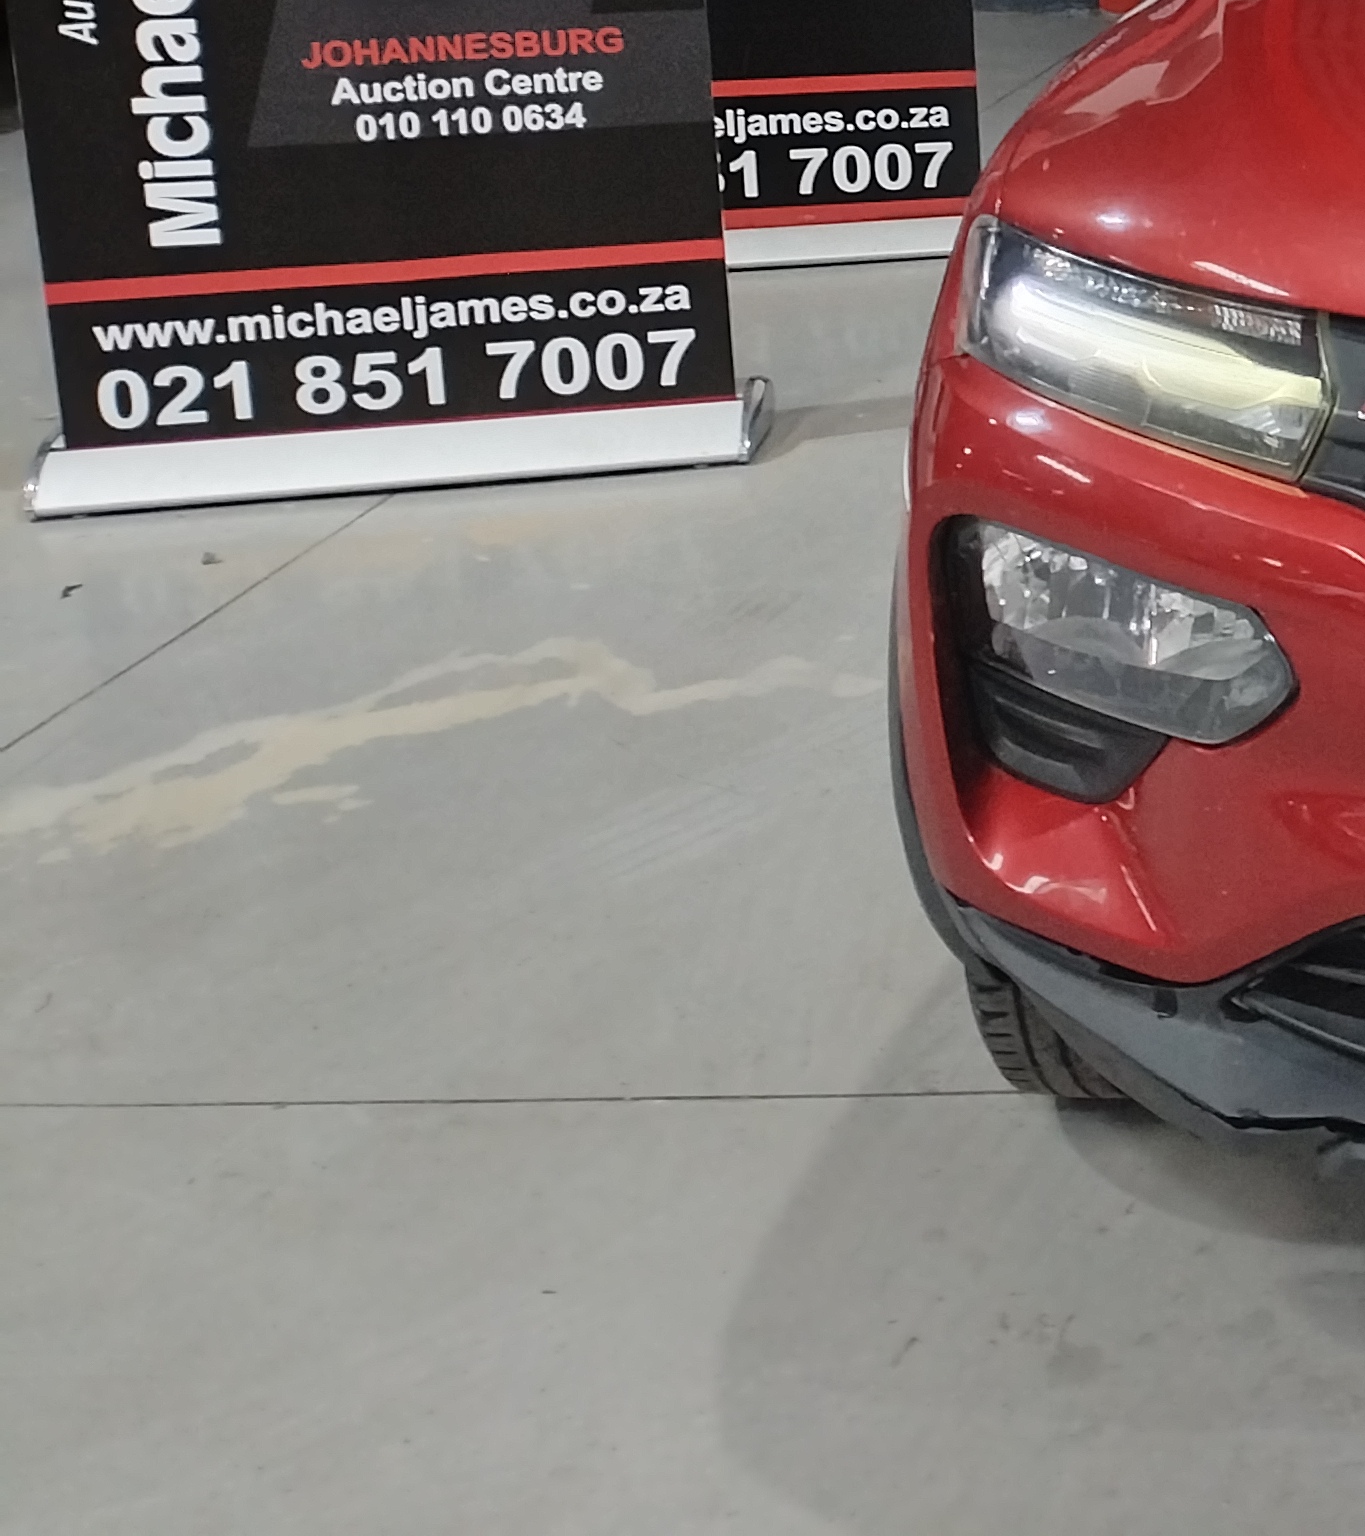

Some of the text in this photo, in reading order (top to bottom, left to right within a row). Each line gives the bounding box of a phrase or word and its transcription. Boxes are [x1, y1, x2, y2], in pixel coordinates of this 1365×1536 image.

[301, 26, 625, 70] JOHANNESBURG
[330, 66, 604, 106] Auction Centre
[355, 101, 588, 142] 010 110 0634
[712, 105, 950, 144] eljames.co.za
[788, 141, 954, 195] 7007
[93, 283, 690, 352] www.michaeljames.co.za
[97, 327, 696, 430] 021 851 7007
